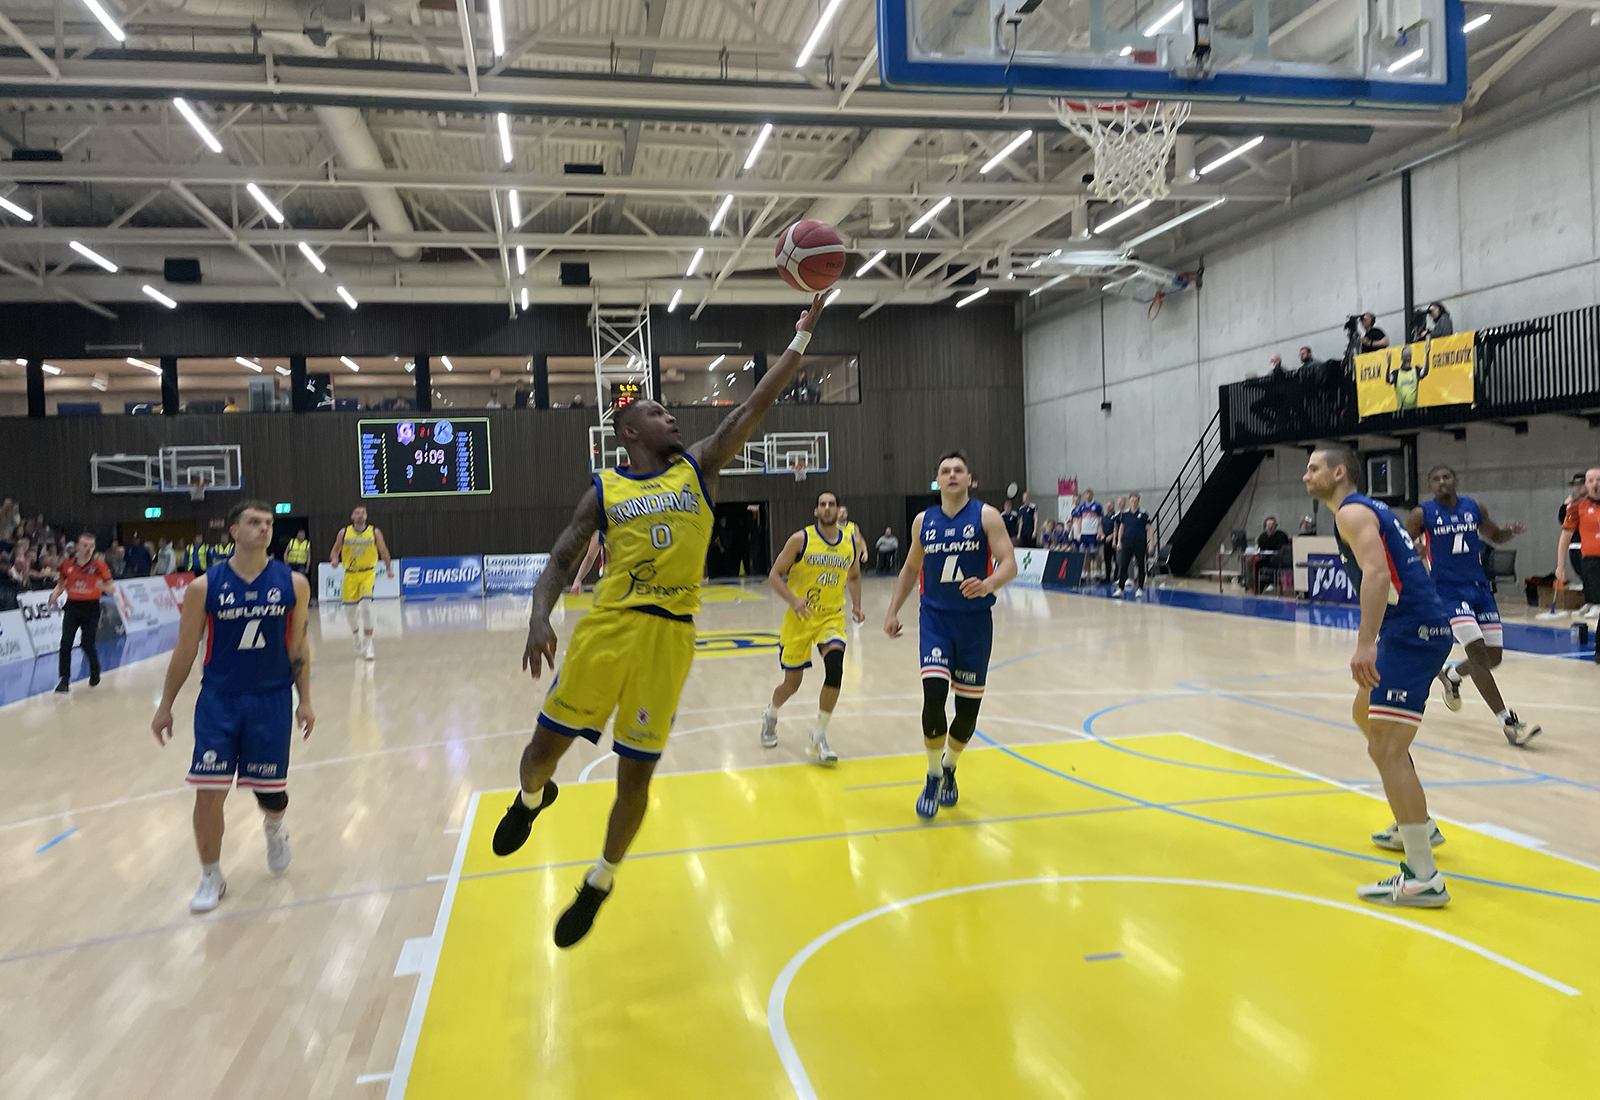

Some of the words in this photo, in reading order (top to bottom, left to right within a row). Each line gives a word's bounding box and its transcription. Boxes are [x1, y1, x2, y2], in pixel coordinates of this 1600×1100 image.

[1432, 345, 1472, 369] GRINDAVÍK
[1360, 363, 1382, 381] ÁFRAM
[414, 449, 445, 465] 9:09
[406, 465, 414, 479] 3
[439, 465, 448, 477] 4
[649, 522, 673, 550] 0
[925, 528, 937, 541] 12
[424, 567, 482, 585] EIMSKIP
[218, 591, 236, 606] 14
